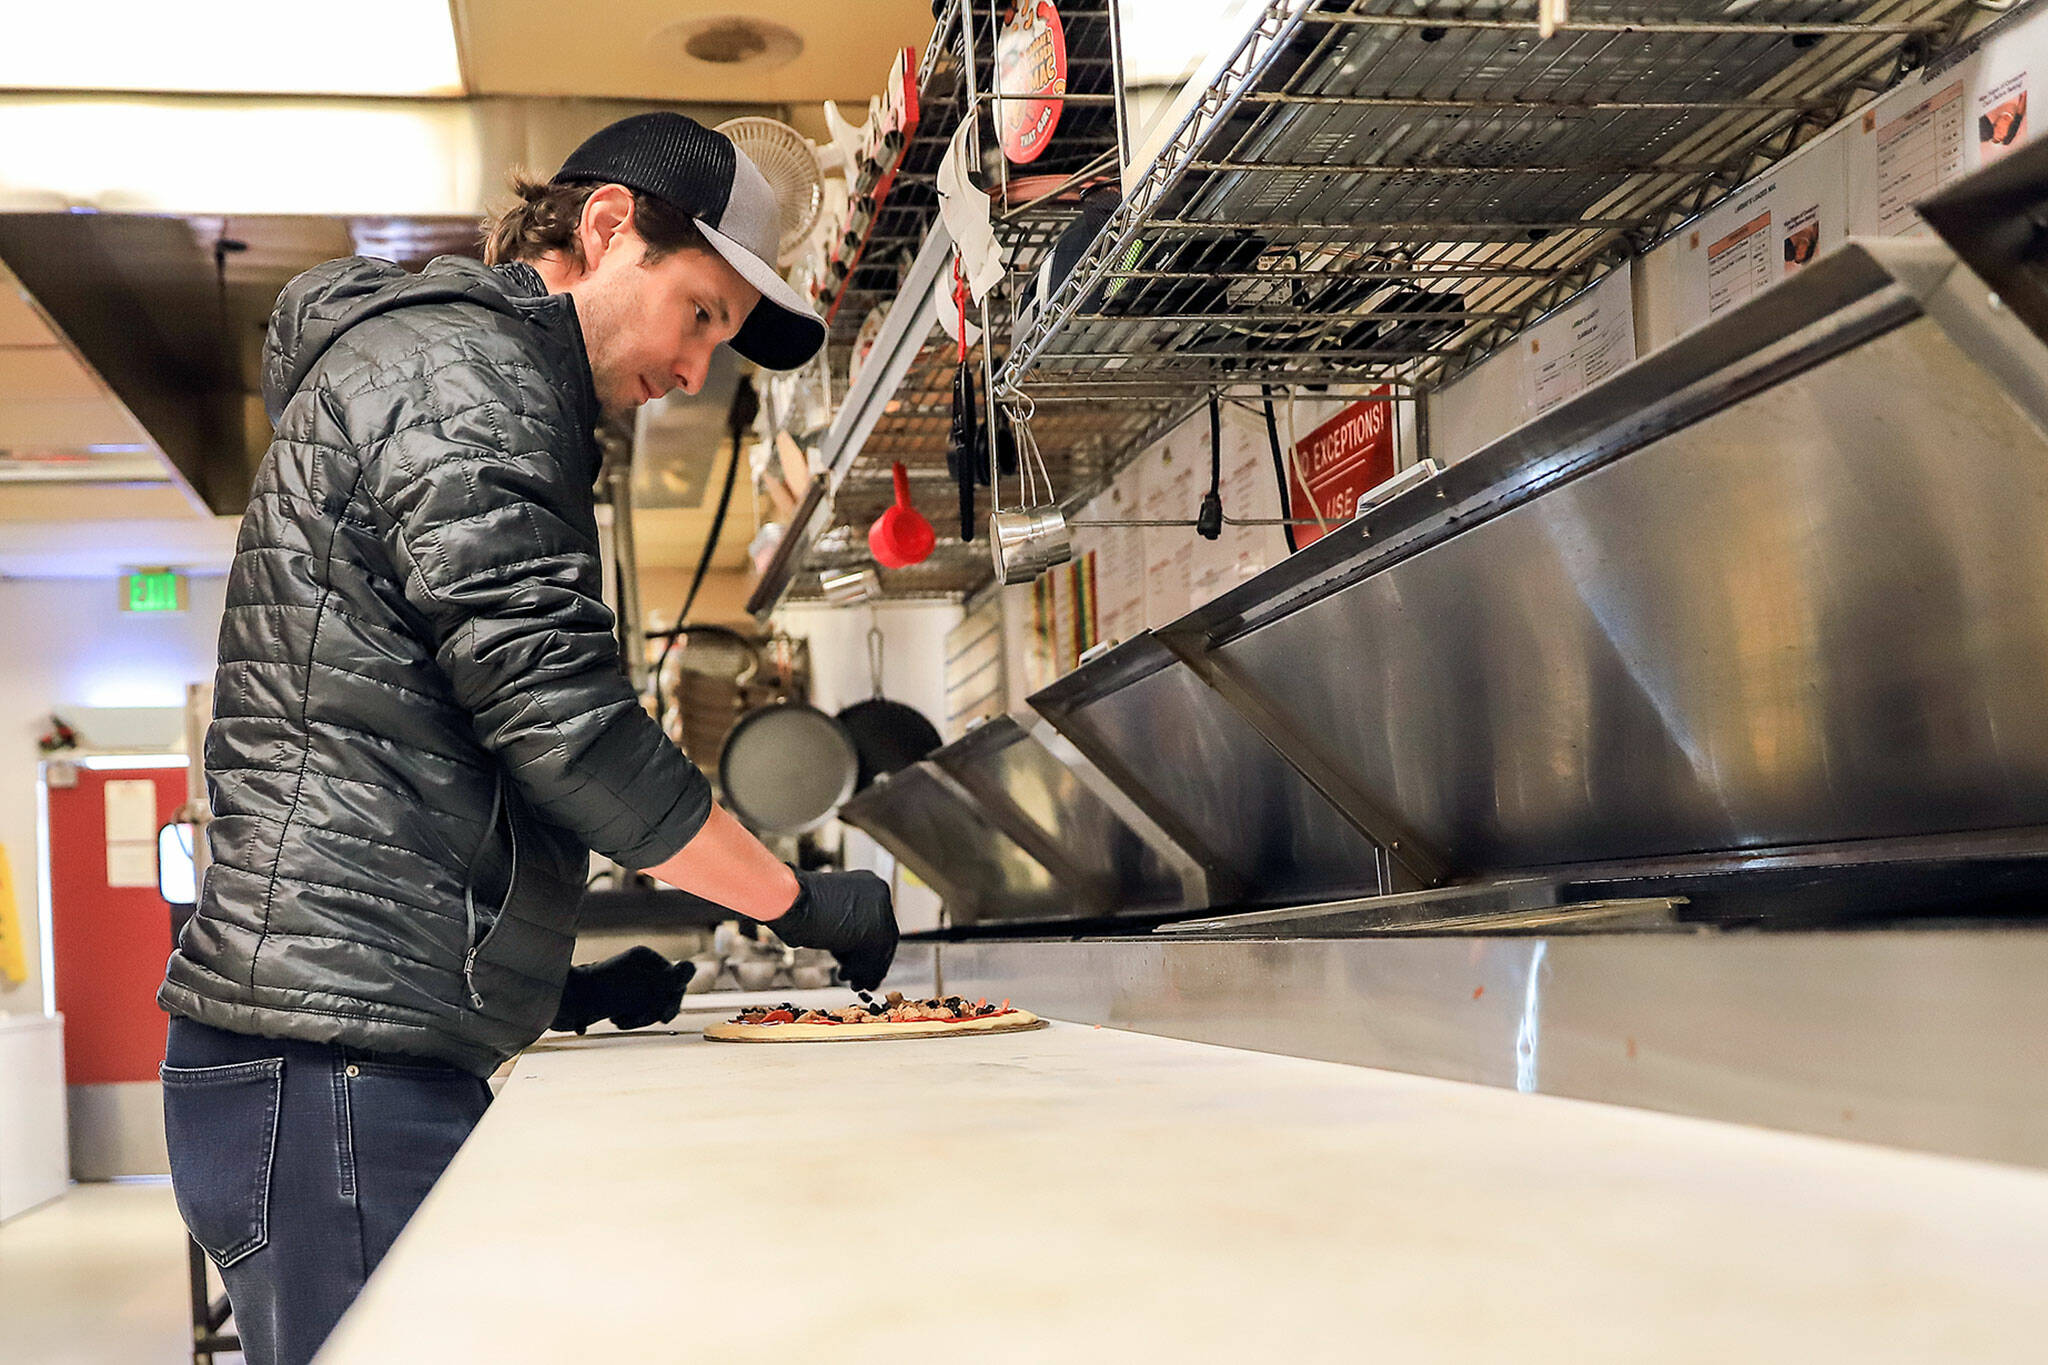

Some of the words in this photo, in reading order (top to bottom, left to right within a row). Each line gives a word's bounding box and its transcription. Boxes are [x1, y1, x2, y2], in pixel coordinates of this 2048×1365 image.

[1020, 129, 1037, 147] THAT
[1036, 106, 1053, 134] GIRL
[1313, 401, 1385, 472] EXCEPTIONS!
[1326, 487, 1354, 520] USE
